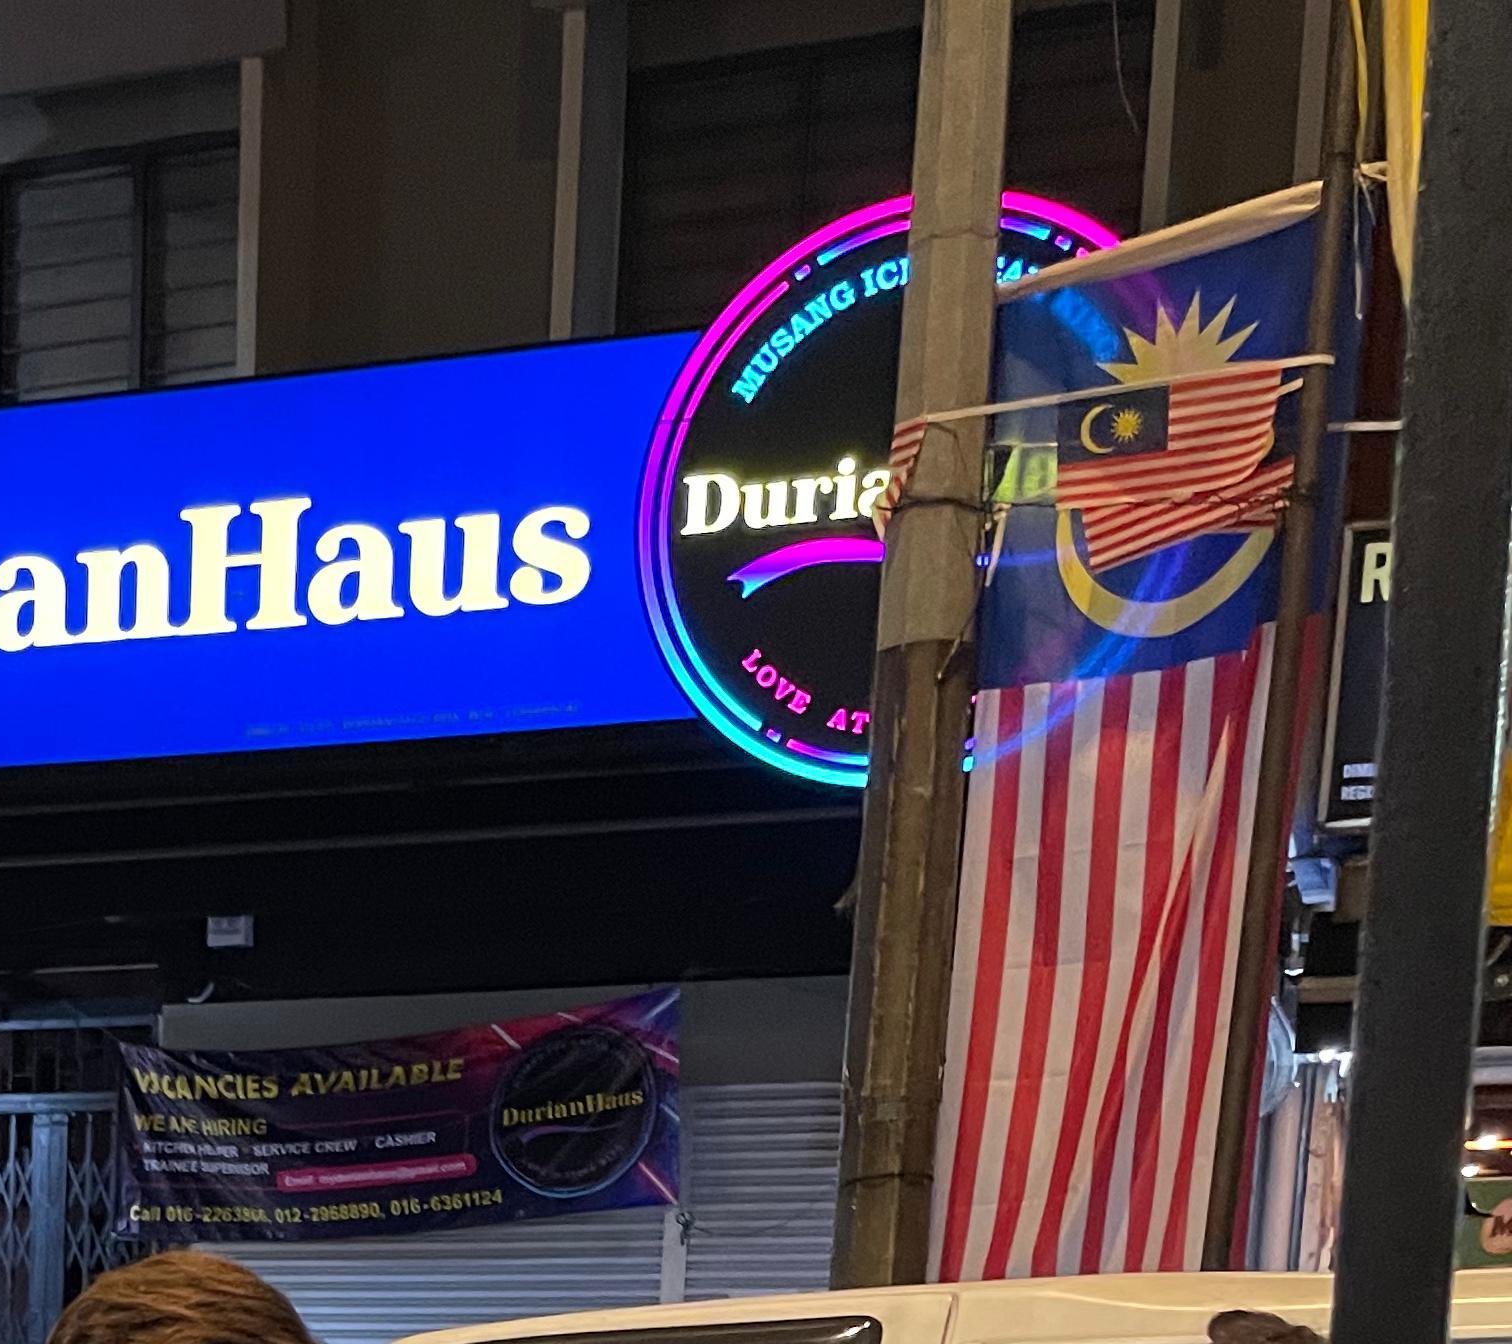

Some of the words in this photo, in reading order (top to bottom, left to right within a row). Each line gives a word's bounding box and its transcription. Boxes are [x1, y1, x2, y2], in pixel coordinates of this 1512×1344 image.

[731, 280, 856, 404] MUSANG
[741, 648, 812, 715] LOVE
[826, 707, 871, 735] AT
[290, 1057, 465, 1097] AVAILABLE
[134, 1113, 165, 1132] WE
[202, 1118, 268, 1136] HIRING
[502, 1089, 644, 1127] DurianHaus
[252, 1142, 310, 1157] SERVICE
[315, 1139, 358, 1153] CREW
[374, 1130, 437, 1149] CASHIER
[129, 1203, 161, 1222] Call
